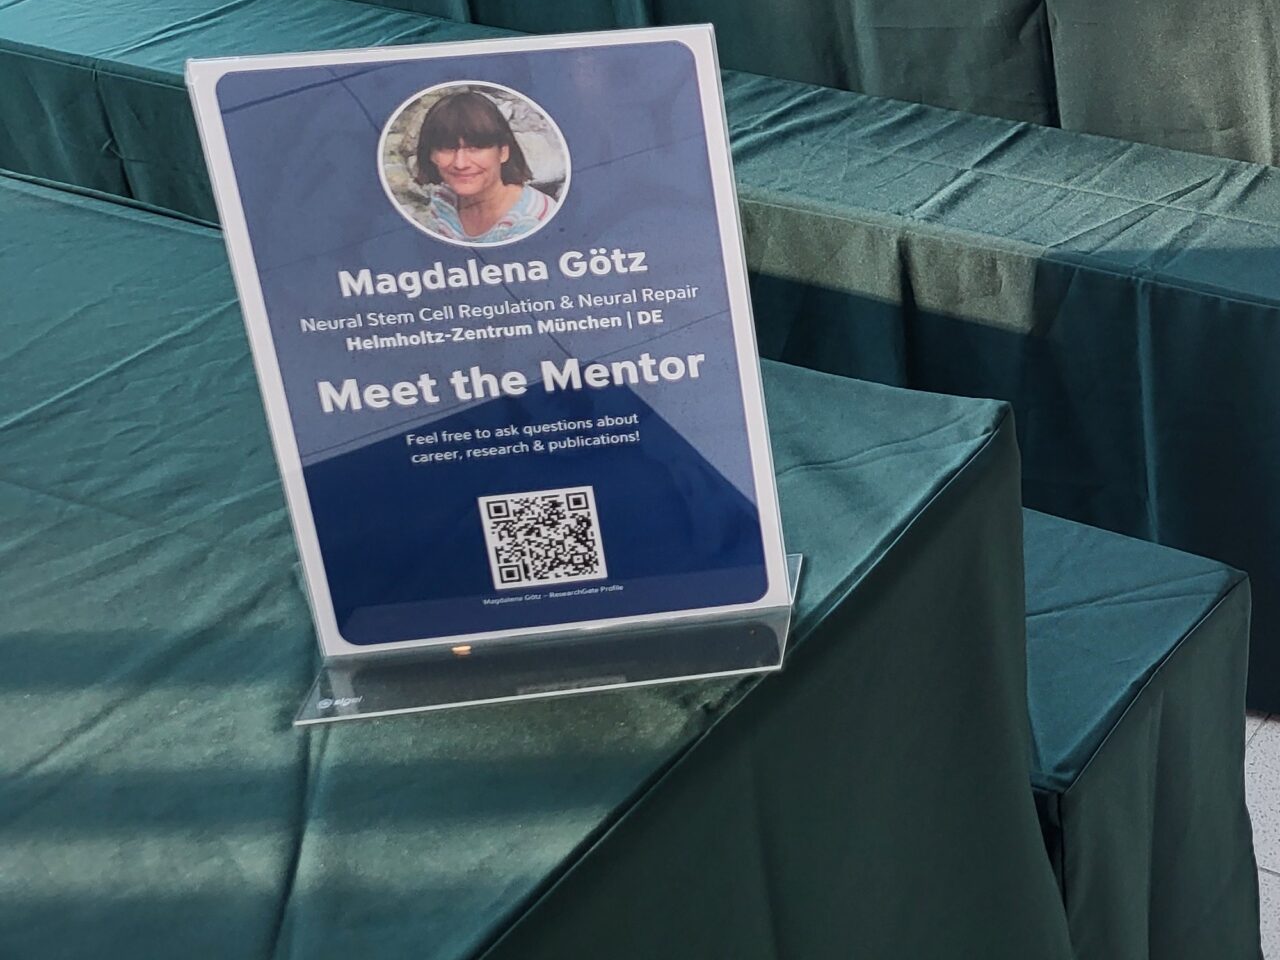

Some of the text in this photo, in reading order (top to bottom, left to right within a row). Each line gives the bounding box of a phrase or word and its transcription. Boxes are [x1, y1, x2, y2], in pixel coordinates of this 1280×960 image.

[338, 247, 648, 299] Magdalena Götz
[300, 284, 698, 333] Neural Stem Cell Regulation & Neural Repair
[346, 323, 533, 352] Helmholtz-Zentrum
[538, 313, 622, 334] München
[637, 309, 664, 325] DE
[318, 352, 705, 413] Meet the Mentor
[406, 413, 638, 447] Feel free to ask questions about
[411, 430, 640, 464] career, research & publications!
